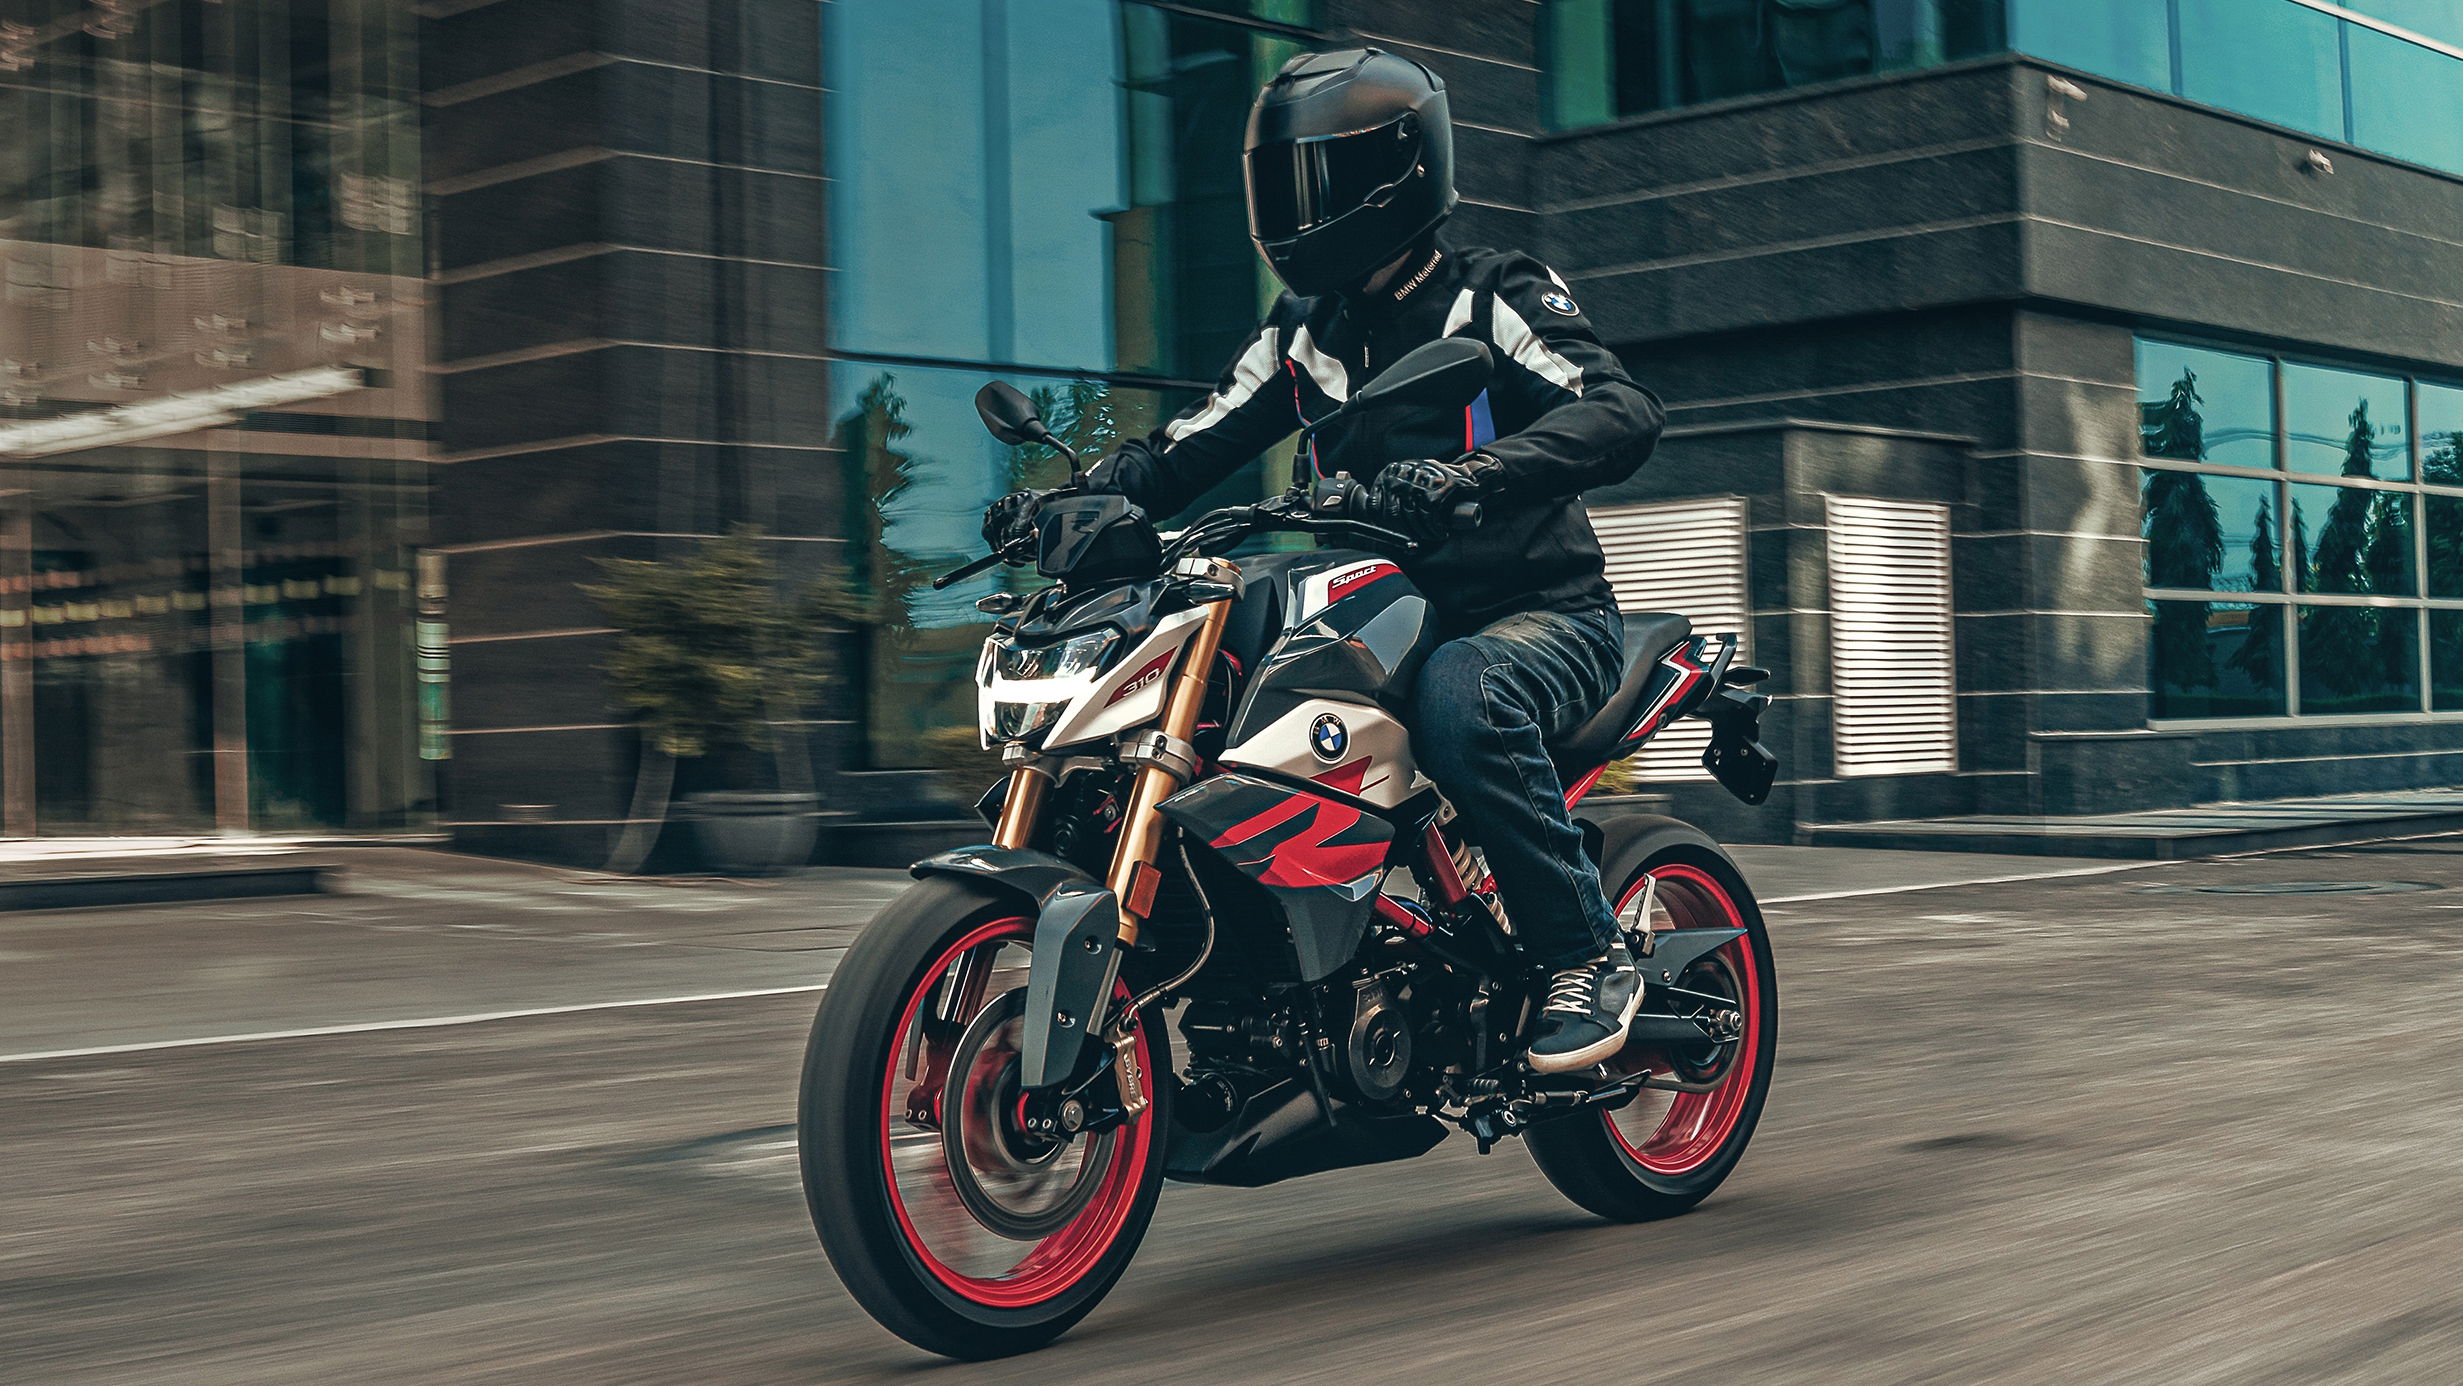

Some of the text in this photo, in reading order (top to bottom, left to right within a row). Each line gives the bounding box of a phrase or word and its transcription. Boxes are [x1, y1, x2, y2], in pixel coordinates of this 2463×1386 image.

[1394, 278, 1418, 301] BMW
[1331, 565, 1377, 589] Sport
[1122, 667, 1160, 697] 310
